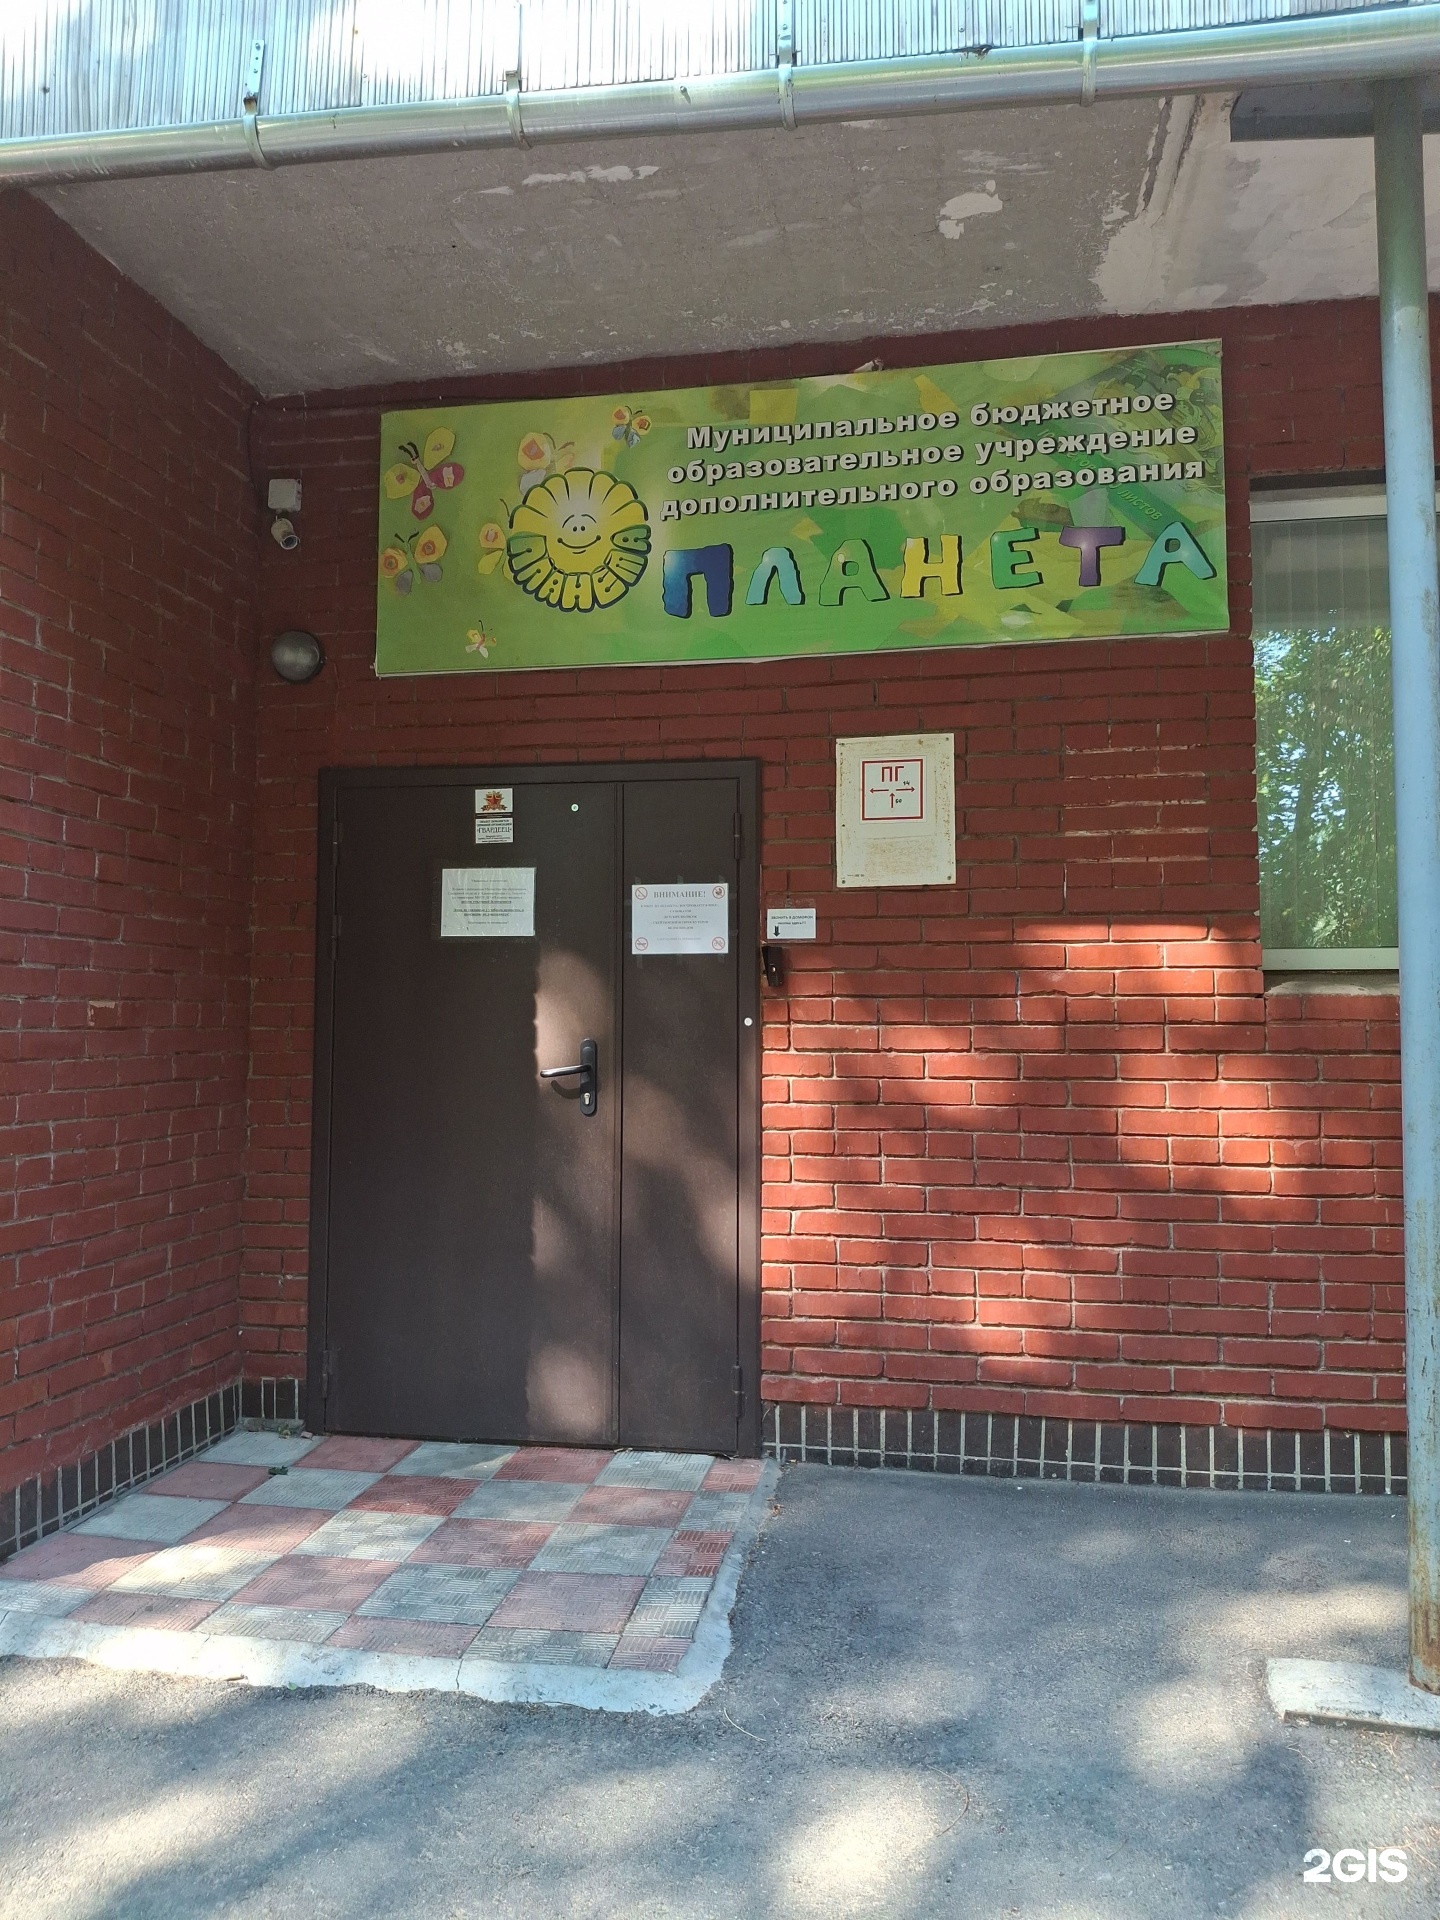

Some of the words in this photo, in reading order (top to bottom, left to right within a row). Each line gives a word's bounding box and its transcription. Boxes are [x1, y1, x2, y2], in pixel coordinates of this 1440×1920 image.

[686, 407, 961, 452] Муниципальное
[970, 389, 1175, 427] бюджетное
[667, 440, 963, 485] образовательное
[974, 424, 1197, 465] учреждение
[660, 475, 958, 521] дополнительного
[969, 459, 1206, 497] образования
[506, 524, 653, 613] ПЛАНЕТА
[663, 521, 1217, 619] ПЛАНЕТА
[881, 766, 905, 782] ПГ
[653, 890, 707, 899] ВНИМАНИЕ!
